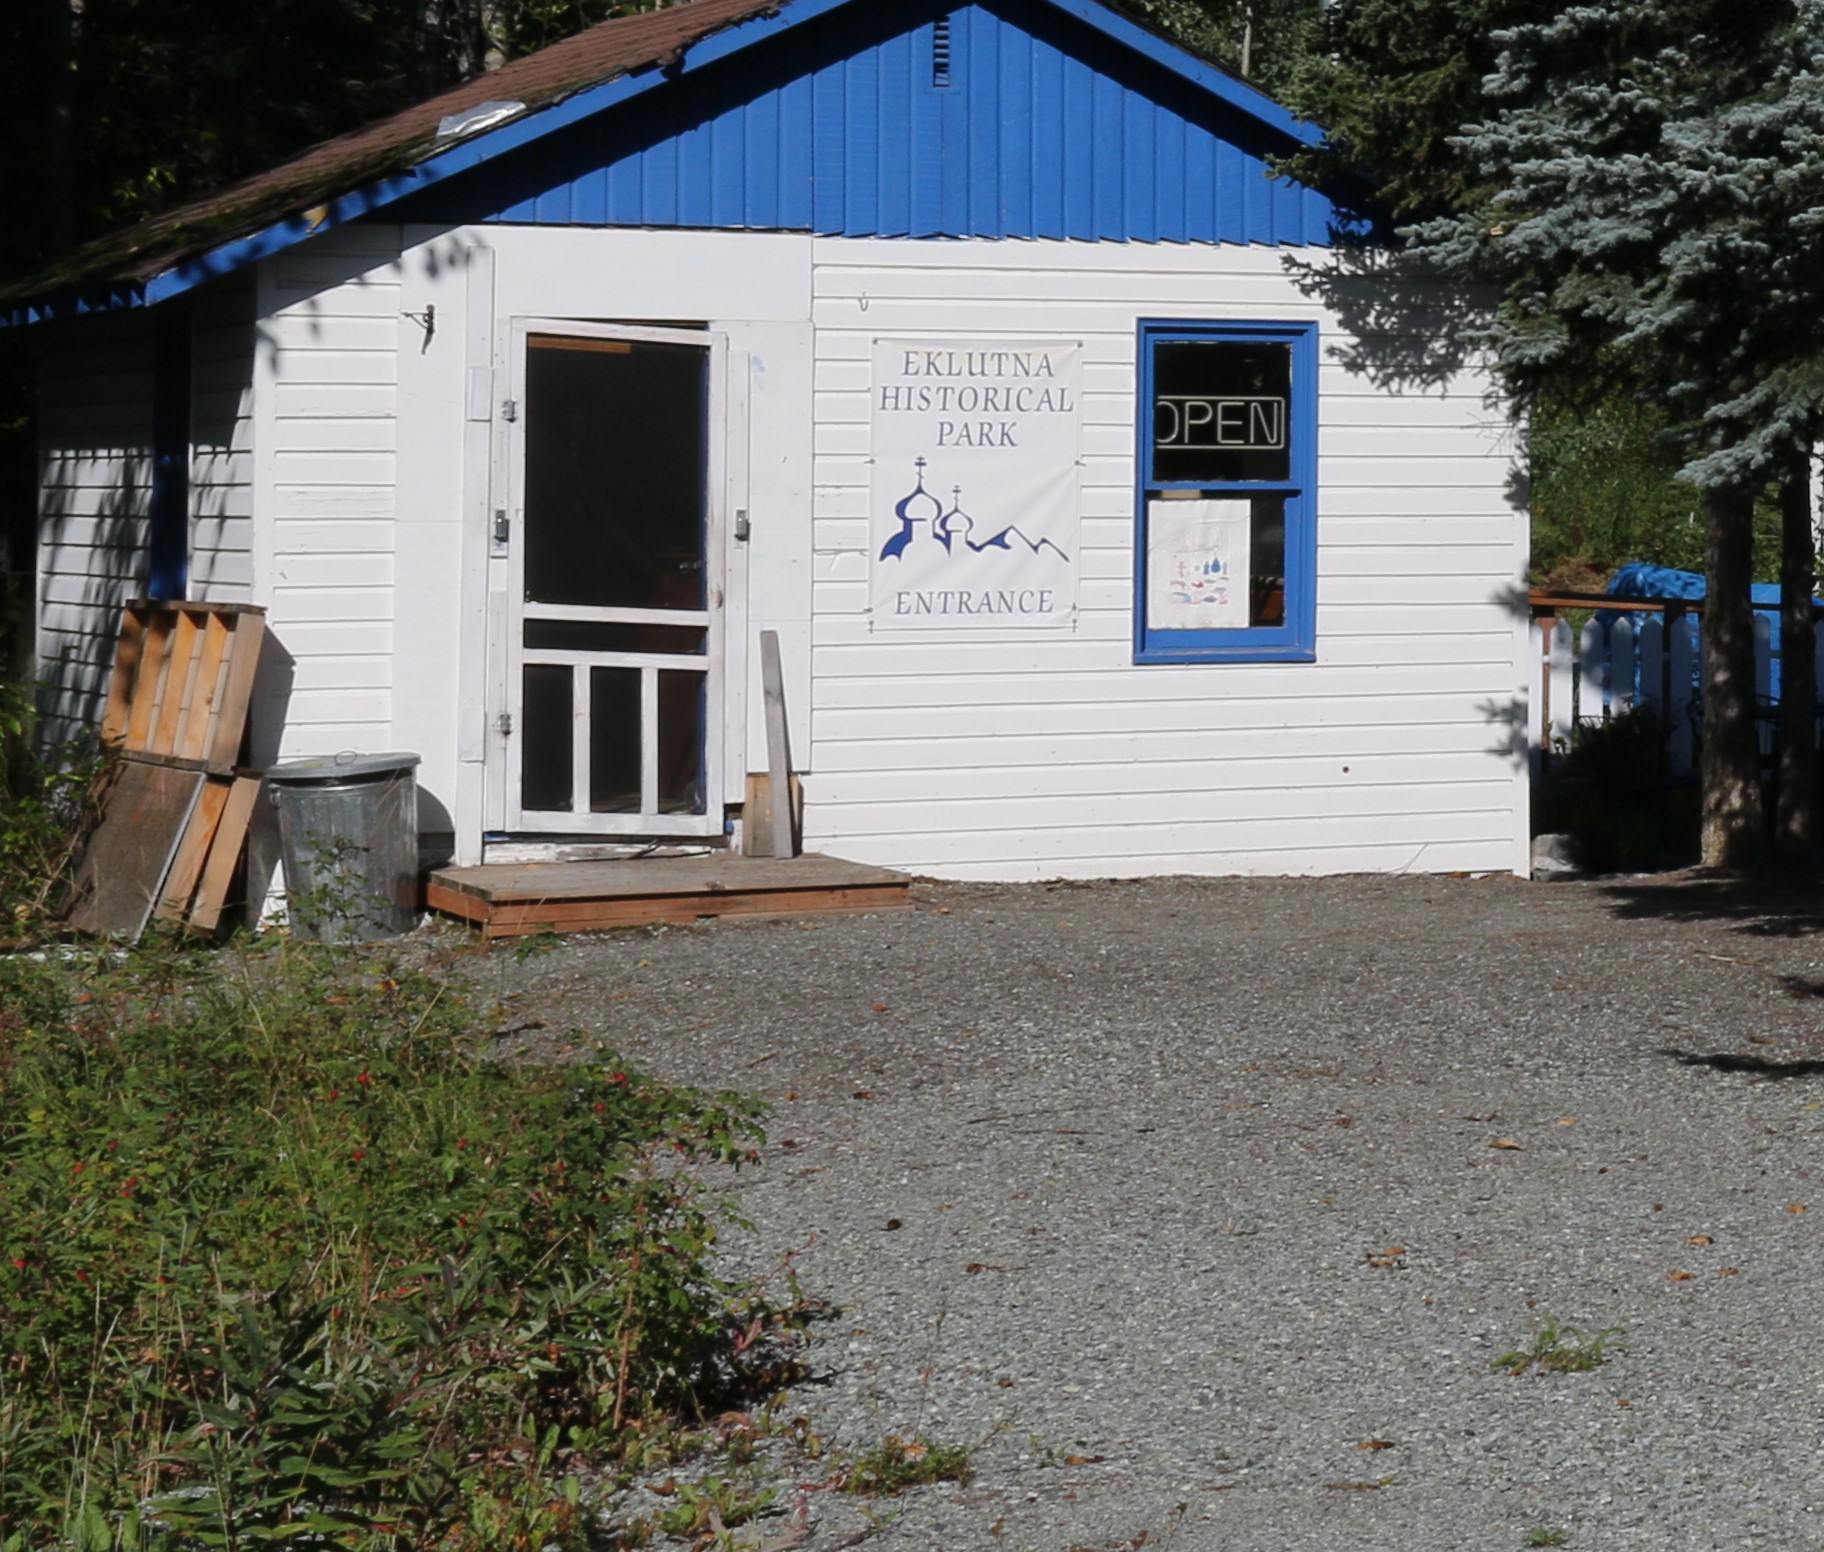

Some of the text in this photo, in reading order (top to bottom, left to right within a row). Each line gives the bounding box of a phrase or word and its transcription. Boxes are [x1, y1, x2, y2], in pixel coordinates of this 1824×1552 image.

[902, 351, 1055, 378] EKLUTNA
[879, 386, 1074, 413] HISTORICAL
[936, 421, 1018, 447] PARK
[895, 590, 1055, 616] ENTRANCE
